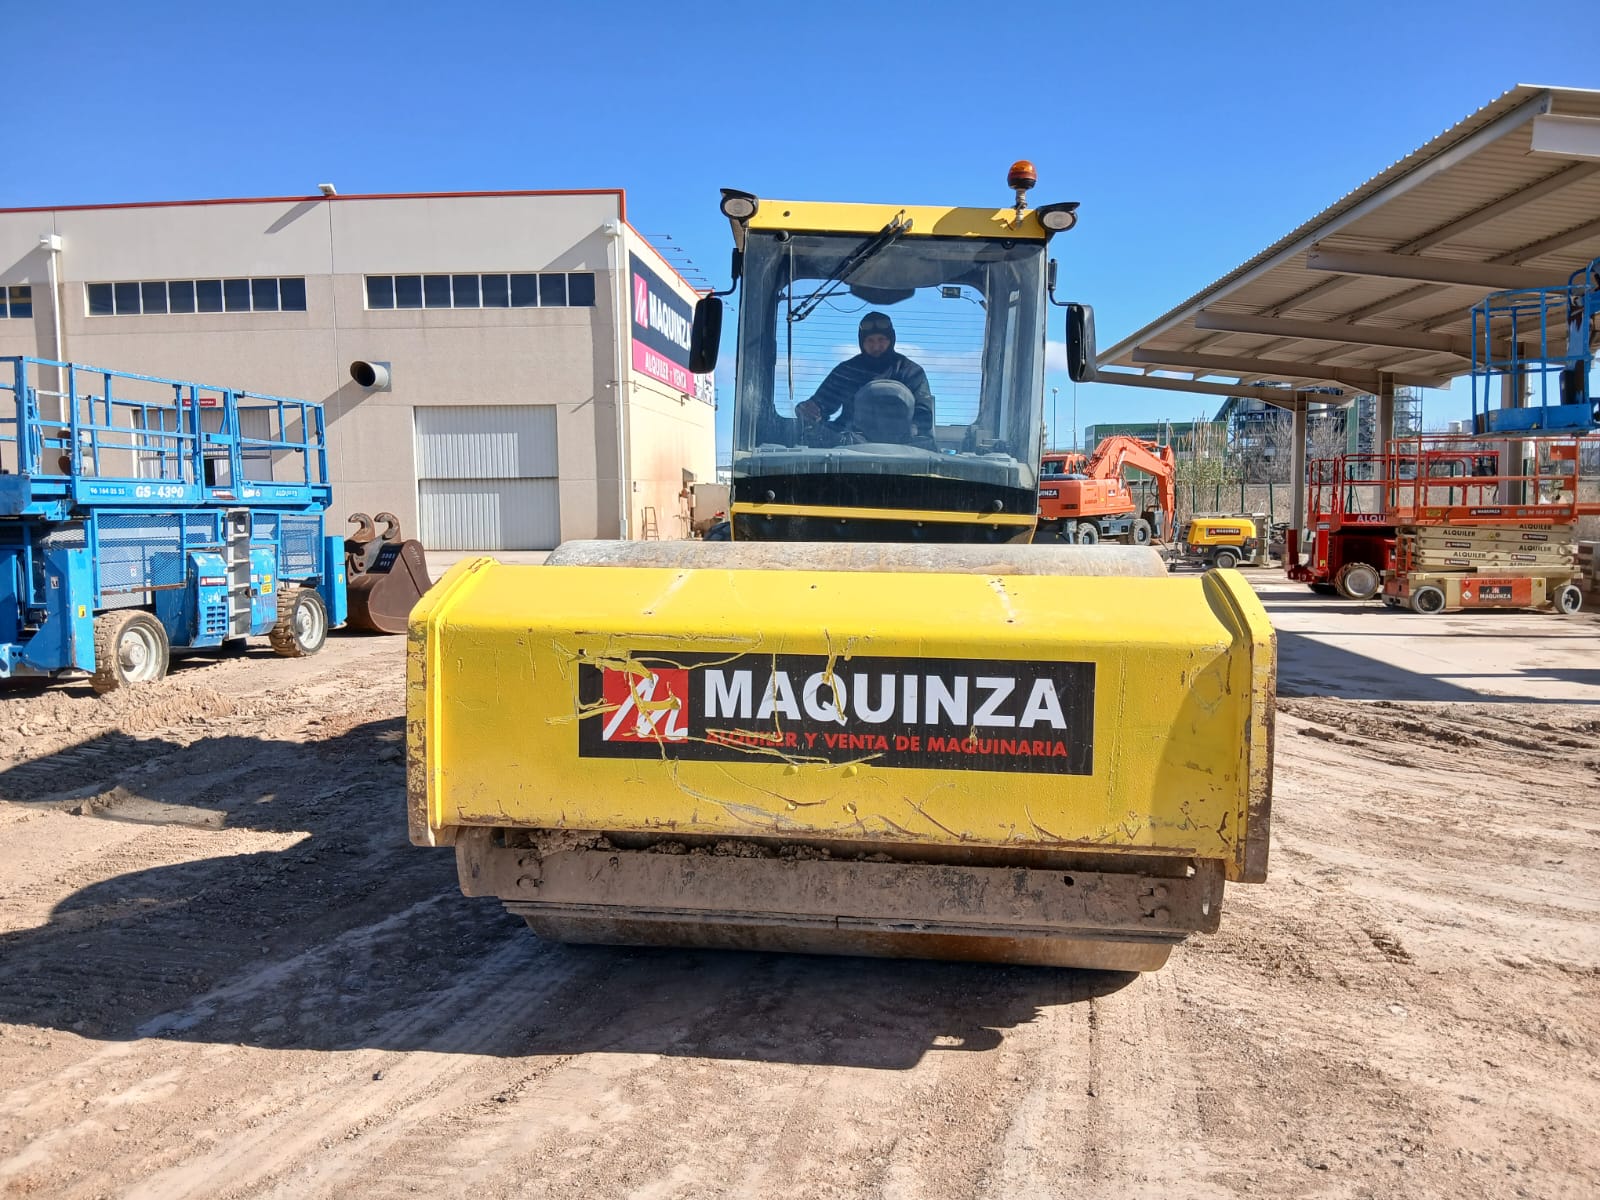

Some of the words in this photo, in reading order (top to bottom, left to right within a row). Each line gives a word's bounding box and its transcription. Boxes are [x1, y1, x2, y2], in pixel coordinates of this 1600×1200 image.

[648, 290, 691, 351] MAQUINZA
[1443, 529, 1476, 537] ALQUILER
[1453, 551, 1486, 559] ALQUILER
[1519, 544, 1552, 552] ALQUILER
[704, 669, 1067, 729] MAQUINZA
[804, 732, 818, 748] Y
[824, 733, 889, 750] VENTA
[895, 736, 920, 751] DE
[927, 737, 1068, 757] MAQUINARIA
